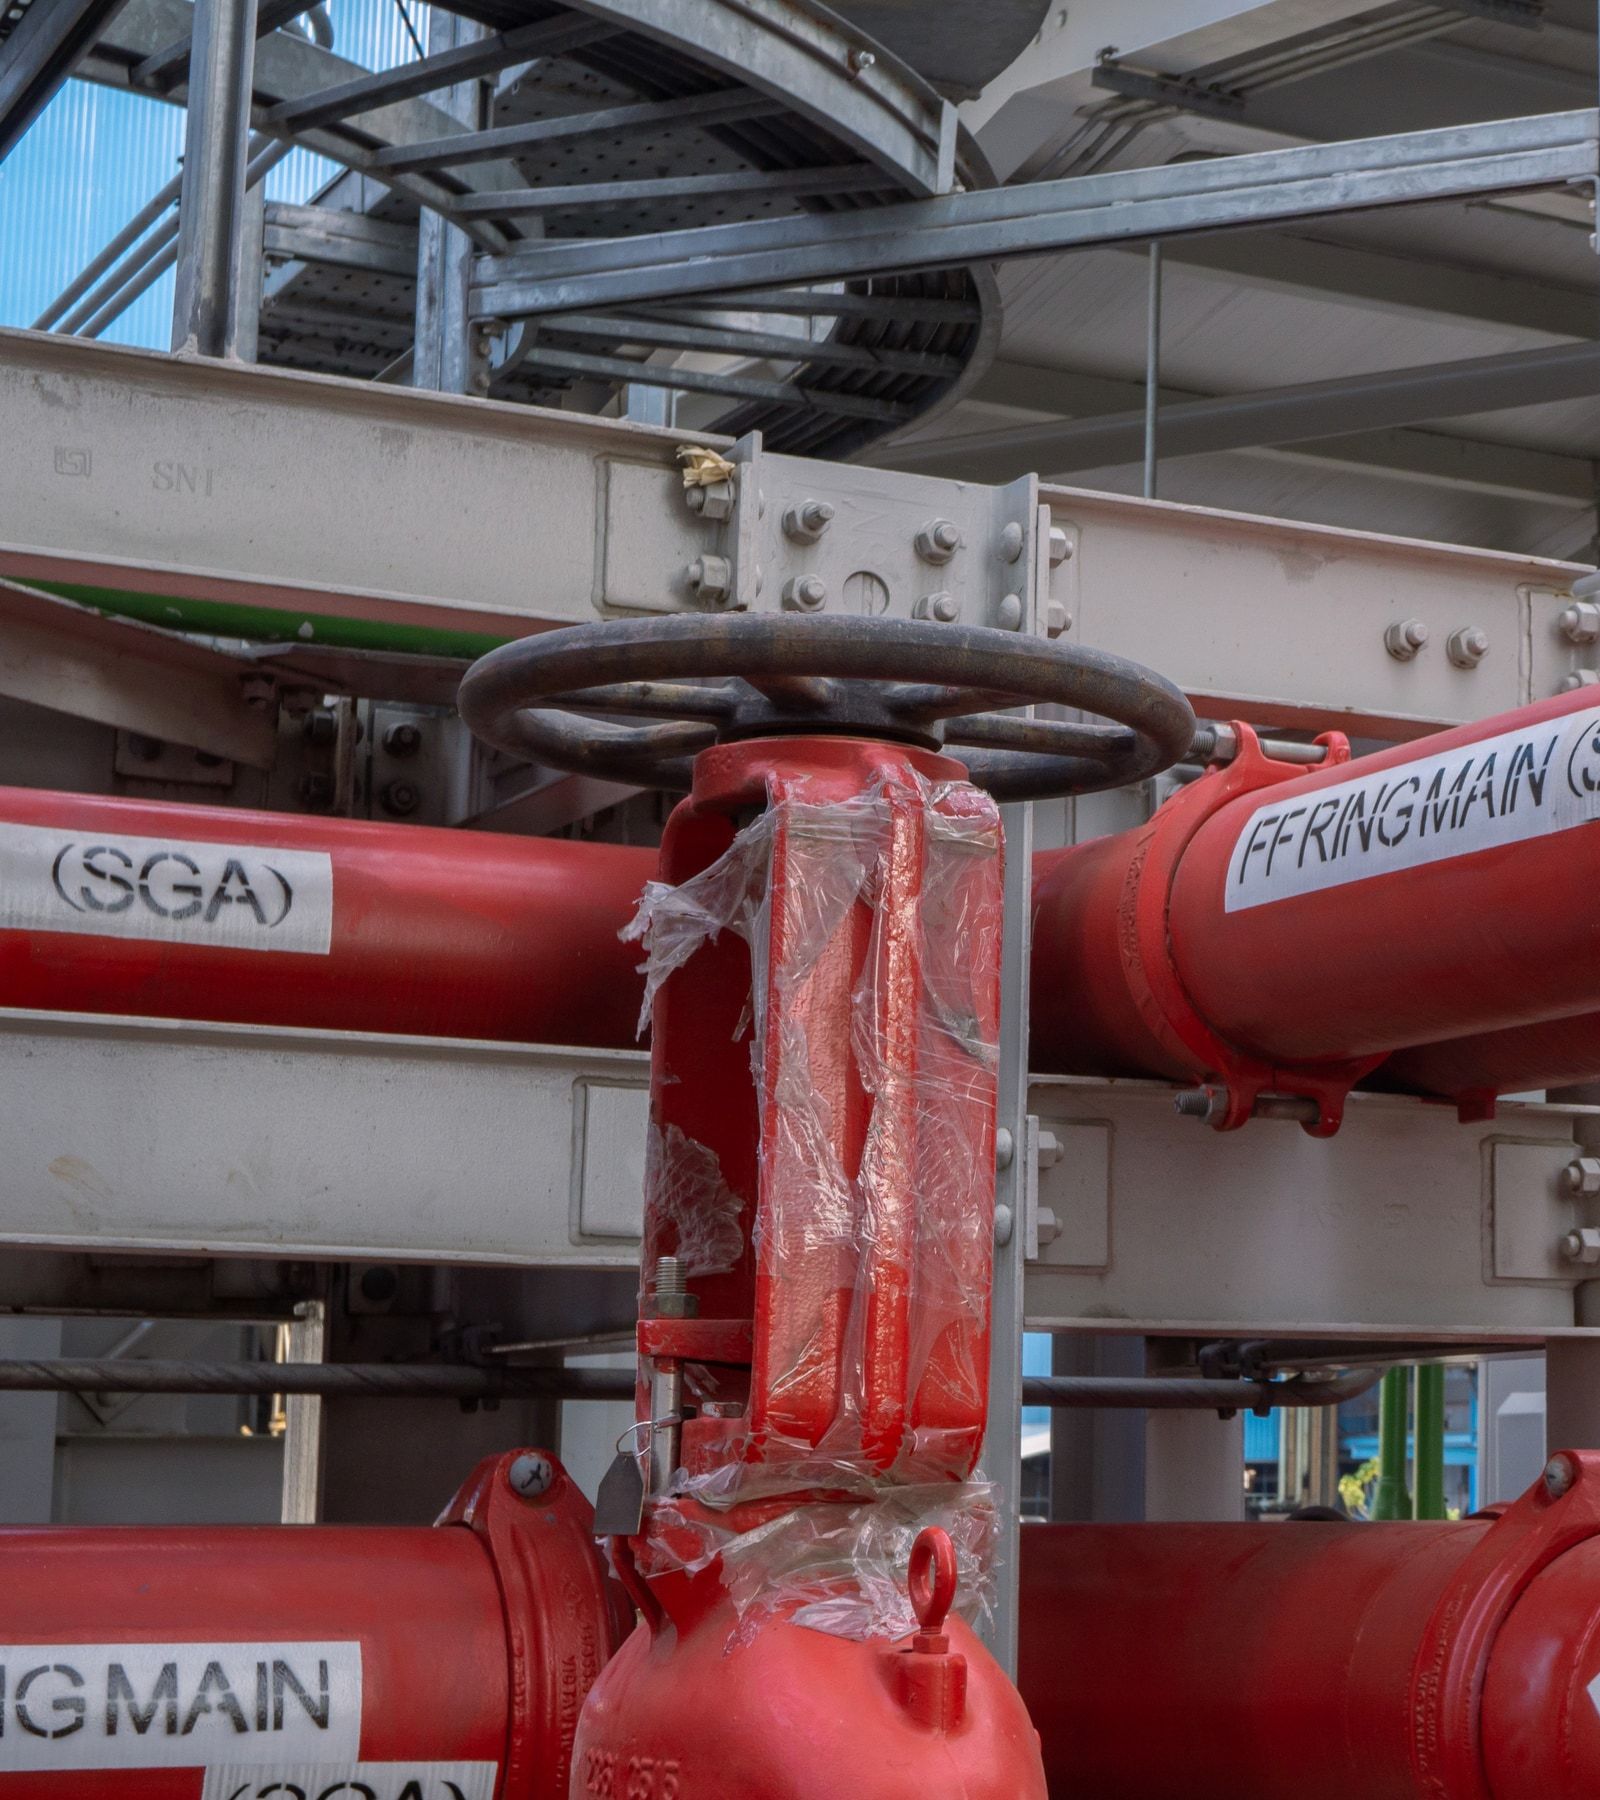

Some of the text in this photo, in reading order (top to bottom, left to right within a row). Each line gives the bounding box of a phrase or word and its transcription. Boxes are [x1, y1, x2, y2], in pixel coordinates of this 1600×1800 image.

[52, 842, 293, 928] (SGA)
[0, 1659, 330, 1741] G MAIN
